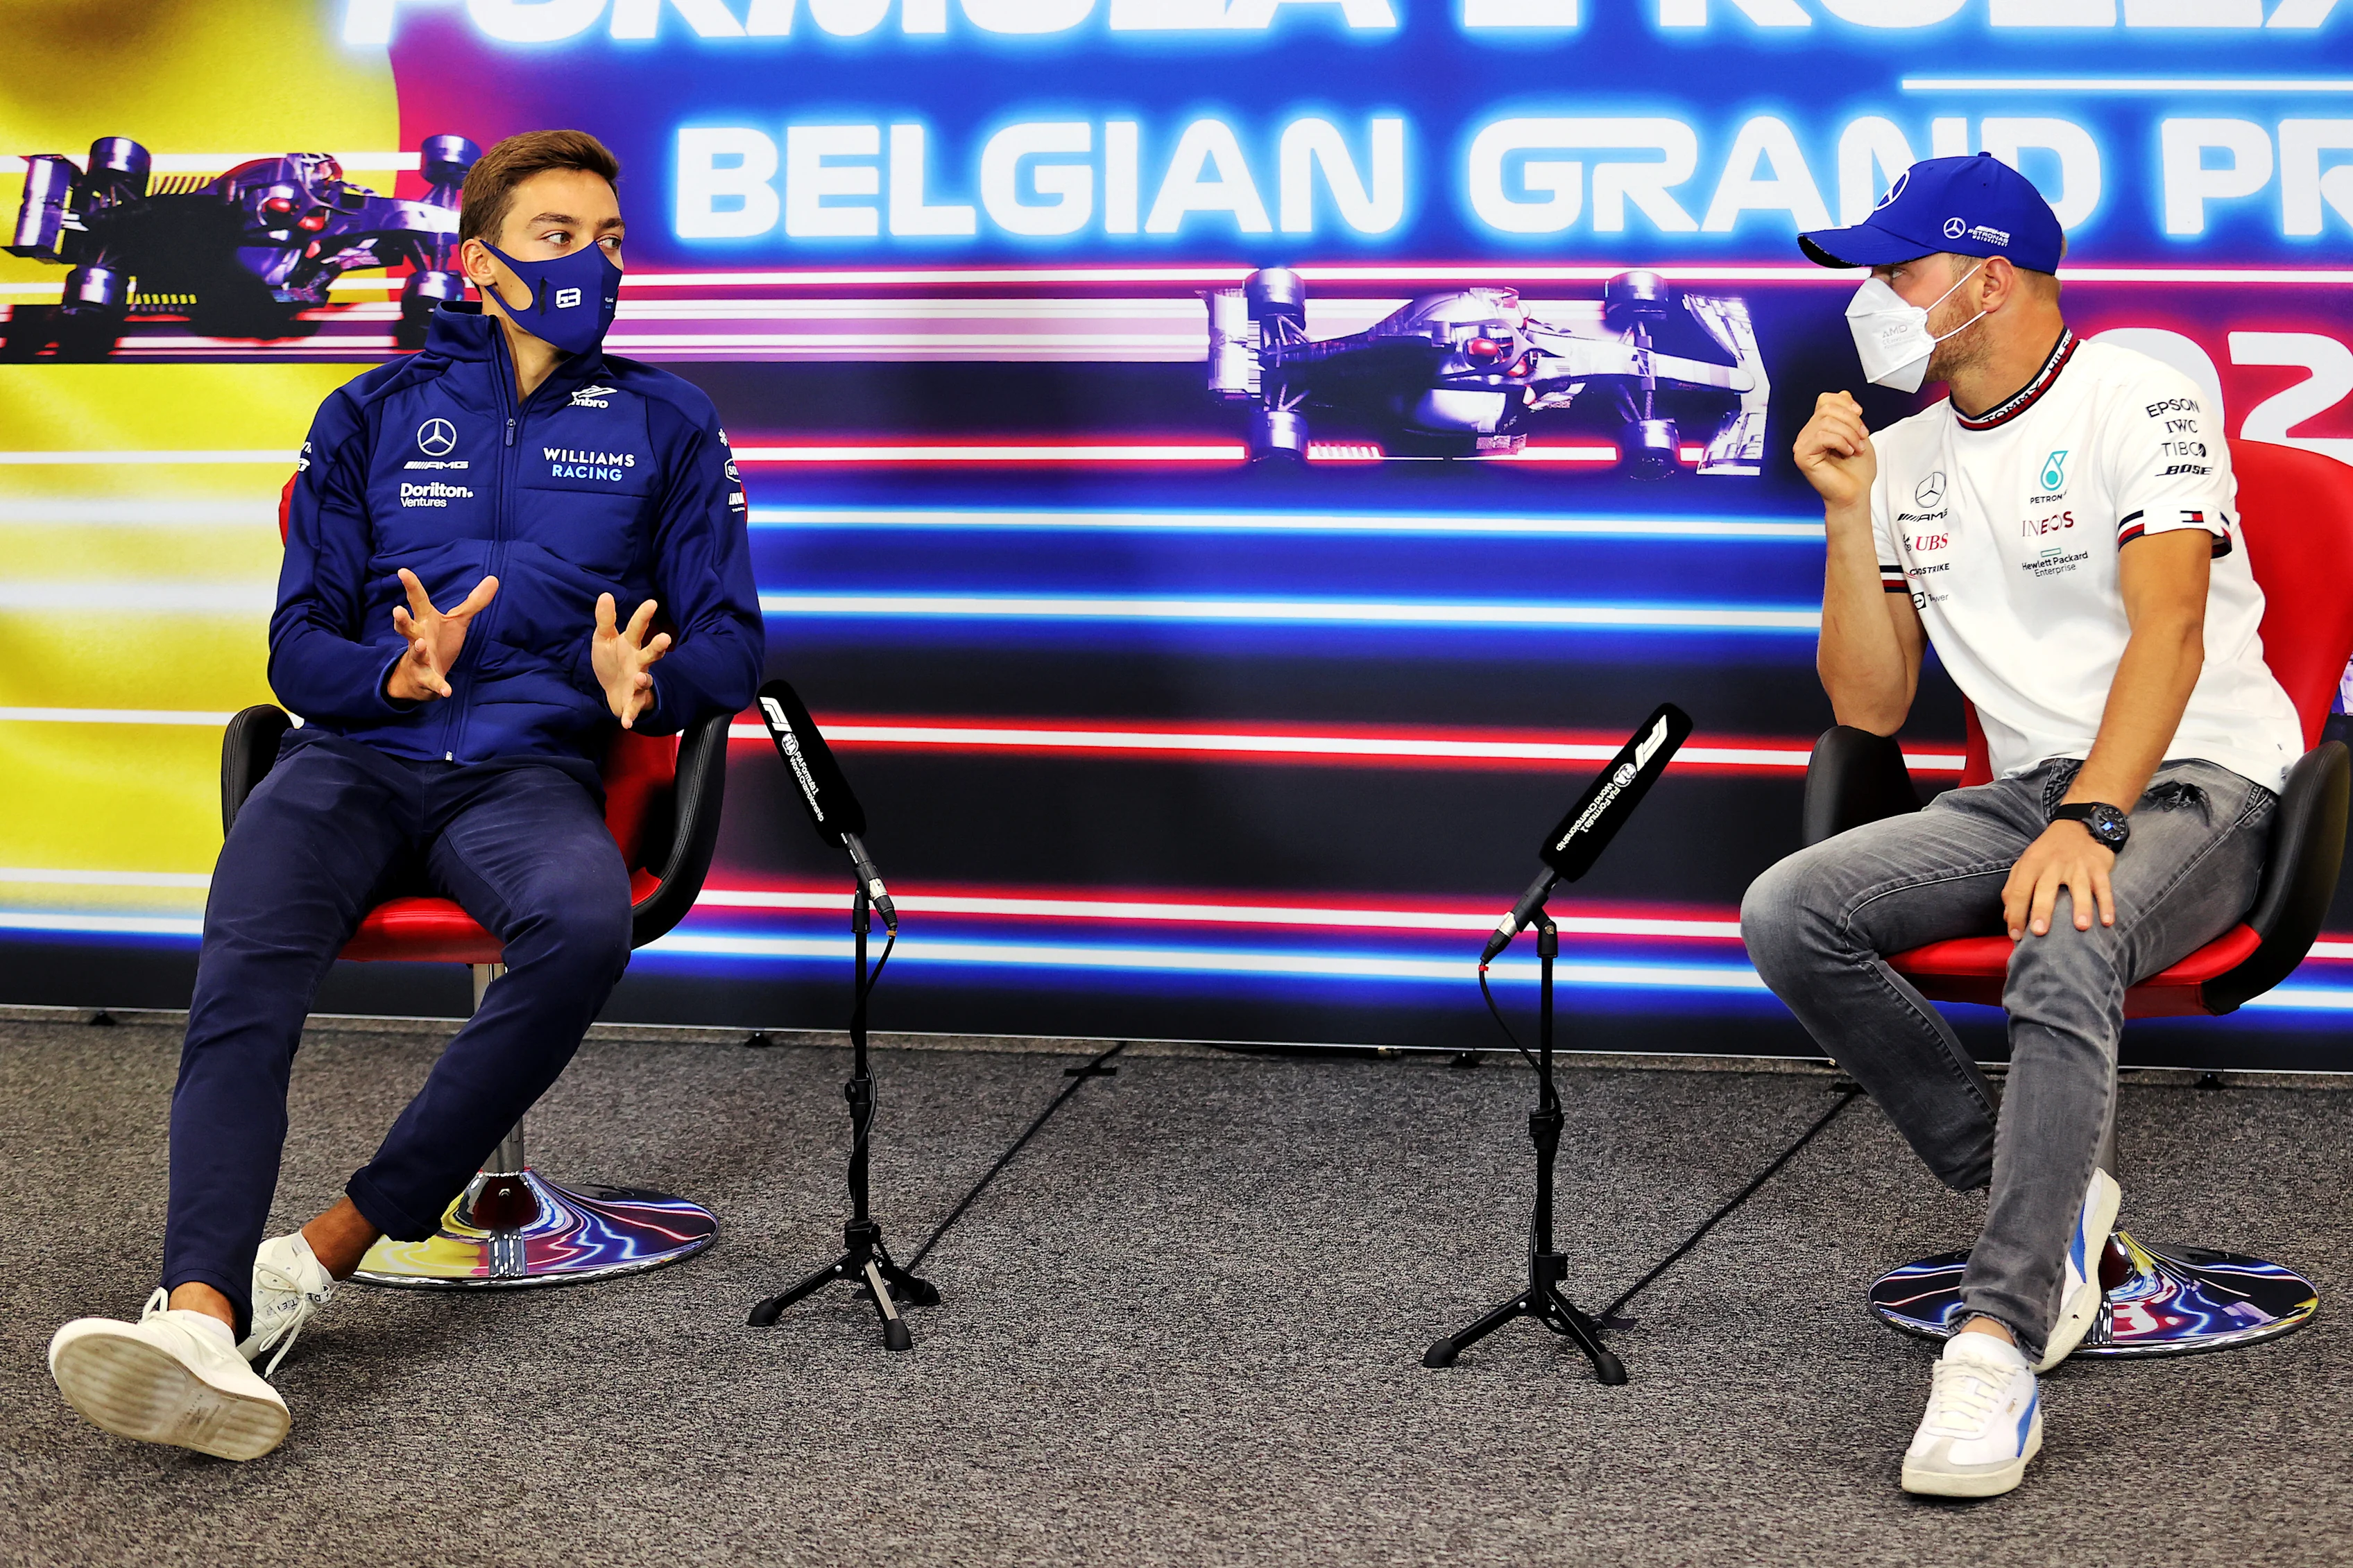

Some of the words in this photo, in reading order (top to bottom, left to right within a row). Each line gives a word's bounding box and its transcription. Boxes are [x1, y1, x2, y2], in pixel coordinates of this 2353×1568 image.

[676, 117, 1403, 238] BELGIAN
[1469, 115, 2101, 234] GRAND
[1967, 228, 2009, 243] PETRONAS
[1971, 235, 2008, 248] MOTORSPORT
[1881, 324, 1908, 338] AMD
[569, 397, 608, 408] mbro
[1983, 381, 2041, 424] TOMMY
[2145, 398, 2200, 417] EPSON
[2164, 419, 2198, 433] IWC
[423, 460, 469, 469] AMG
[543, 447, 635, 467] WILLIAMS
[551, 464, 623, 481] RACING
[2155, 464, 2213, 476] BOSE
[400, 497, 447, 508] Ventures
[2030, 490, 2067, 504] PETRON
[2021, 511, 2074, 537] INEOS
[1915, 533, 1949, 551] UBS
[2021, 559, 2052, 571] Hewlett
[2053, 551, 2089, 565] Packard
[2034, 563, 2076, 577] Enterprise
[799, 761, 816, 791] Formula
[790, 756, 803, 777] World
[799, 775, 824, 822] Championship
[1594, 782, 1615, 805] World
[1584, 798, 1611, 828] Formula
[1556, 802, 1598, 851] Championship
